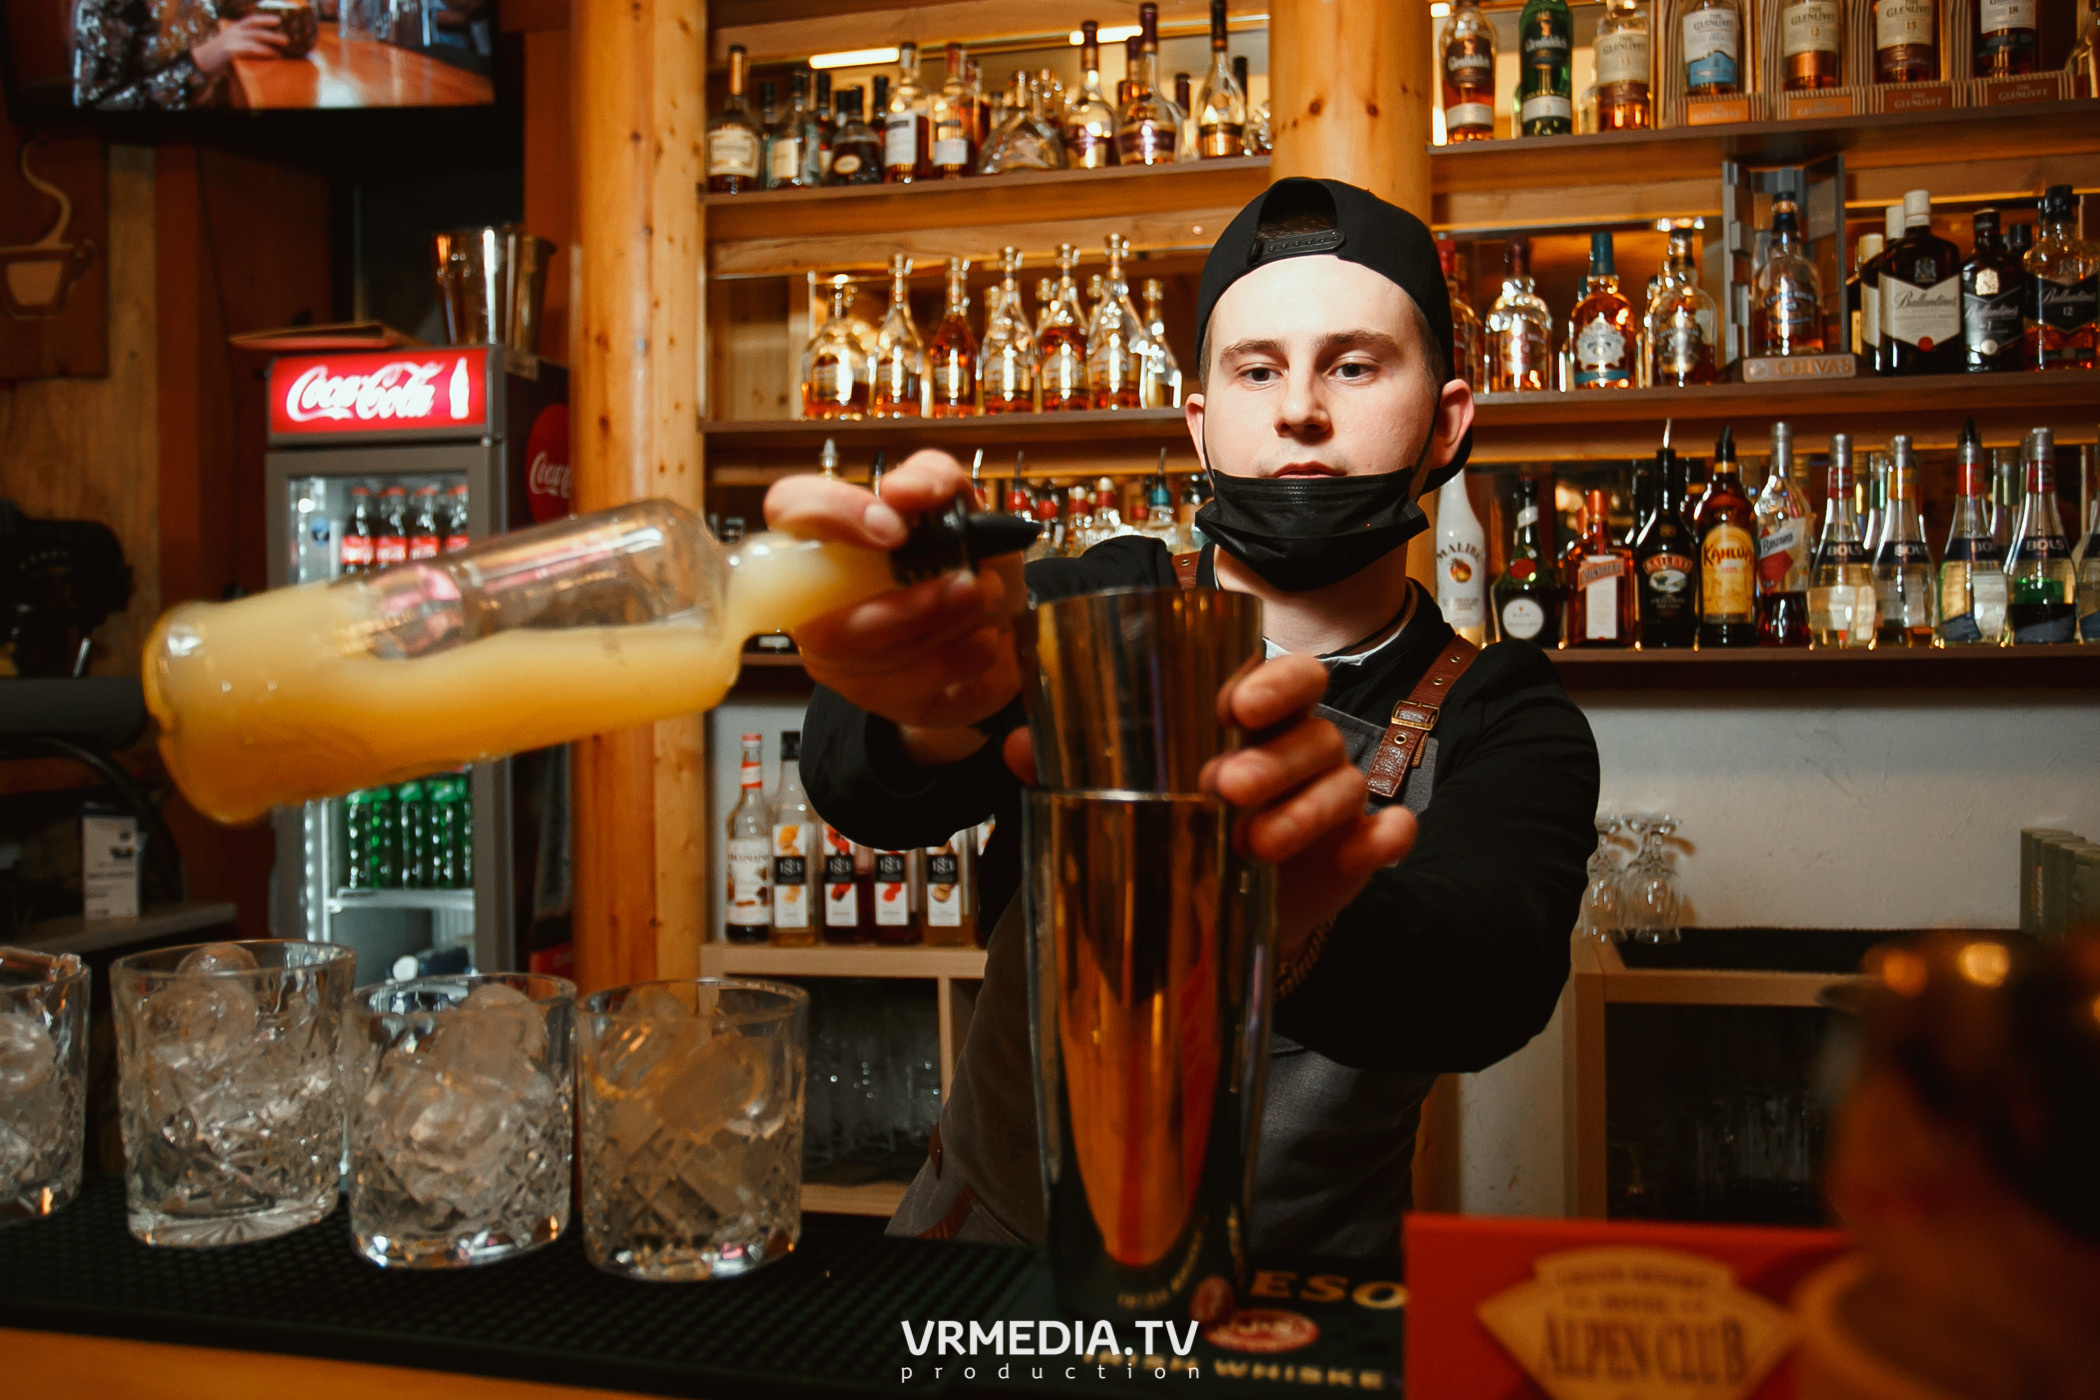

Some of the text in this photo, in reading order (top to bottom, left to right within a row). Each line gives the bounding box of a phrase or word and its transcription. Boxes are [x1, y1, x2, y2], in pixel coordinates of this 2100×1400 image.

[1776, 359, 1851, 377] CHIVAS
[286, 361, 445, 422] Coca-Cola
[1826, 543, 1864, 556] BOLS
[2026, 539, 2065, 551] BOLS
[1249, 1270, 1408, 1309] ESO
[1654, 1316, 1749, 1386] CLUB
[1213, 1359, 1384, 1390] WHISKE
